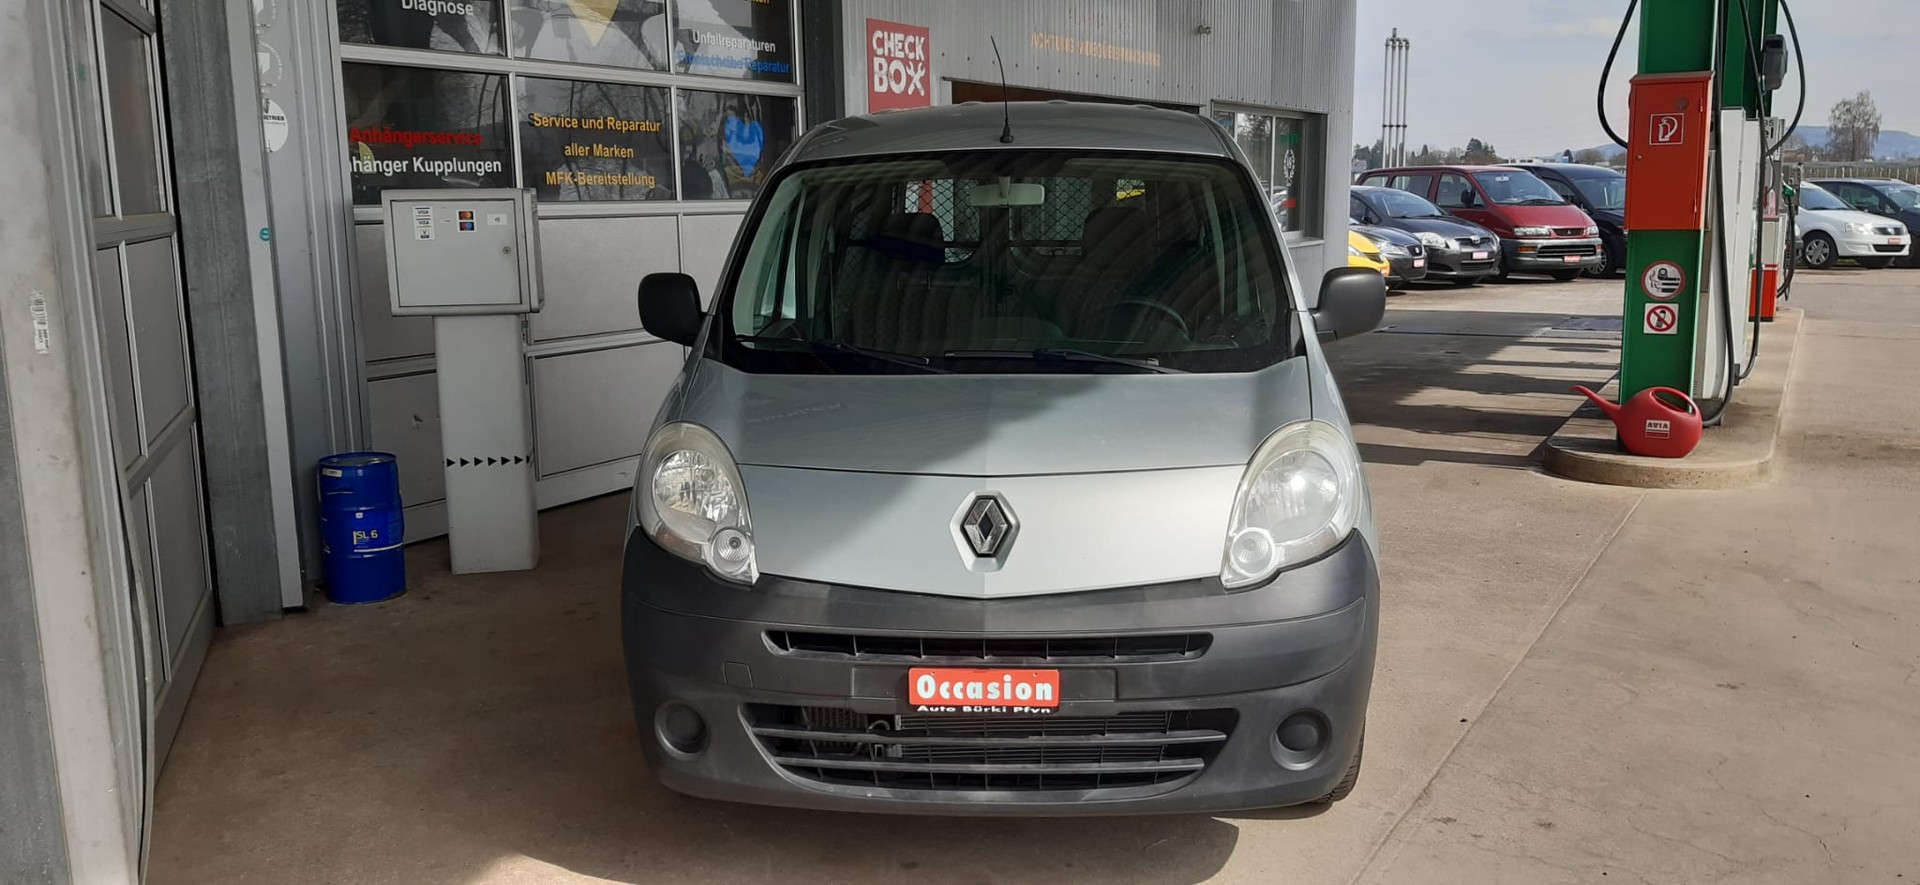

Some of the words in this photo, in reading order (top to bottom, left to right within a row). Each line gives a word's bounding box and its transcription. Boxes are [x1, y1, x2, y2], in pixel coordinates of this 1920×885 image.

[401, 0, 474, 16] Diagnose
[693, 30, 776, 53] Unfallreparaturen
[872, 30, 925, 61] CHECK
[873, 57, 925, 97] BOX
[533, 112, 578, 128] Service
[582, 117, 603, 130] und
[607, 117, 661, 133] Reparatur
[350, 127, 483, 148] Anhängerservice
[565, 143, 589, 157] aller
[593, 144, 634, 158] Marken
[349, 156, 409, 176] hänger
[413, 156, 502, 176] Kupplungen
[545, 171, 656, 189] MFK-Bereitstellung
[1647, 421, 1669, 429] AVIA
[370, 530, 378, 539] 6
[916, 674, 1053, 701] Occasion
[916, 705, 956, 713] Auto
[1013, 706, 1051, 714] Pfyn
